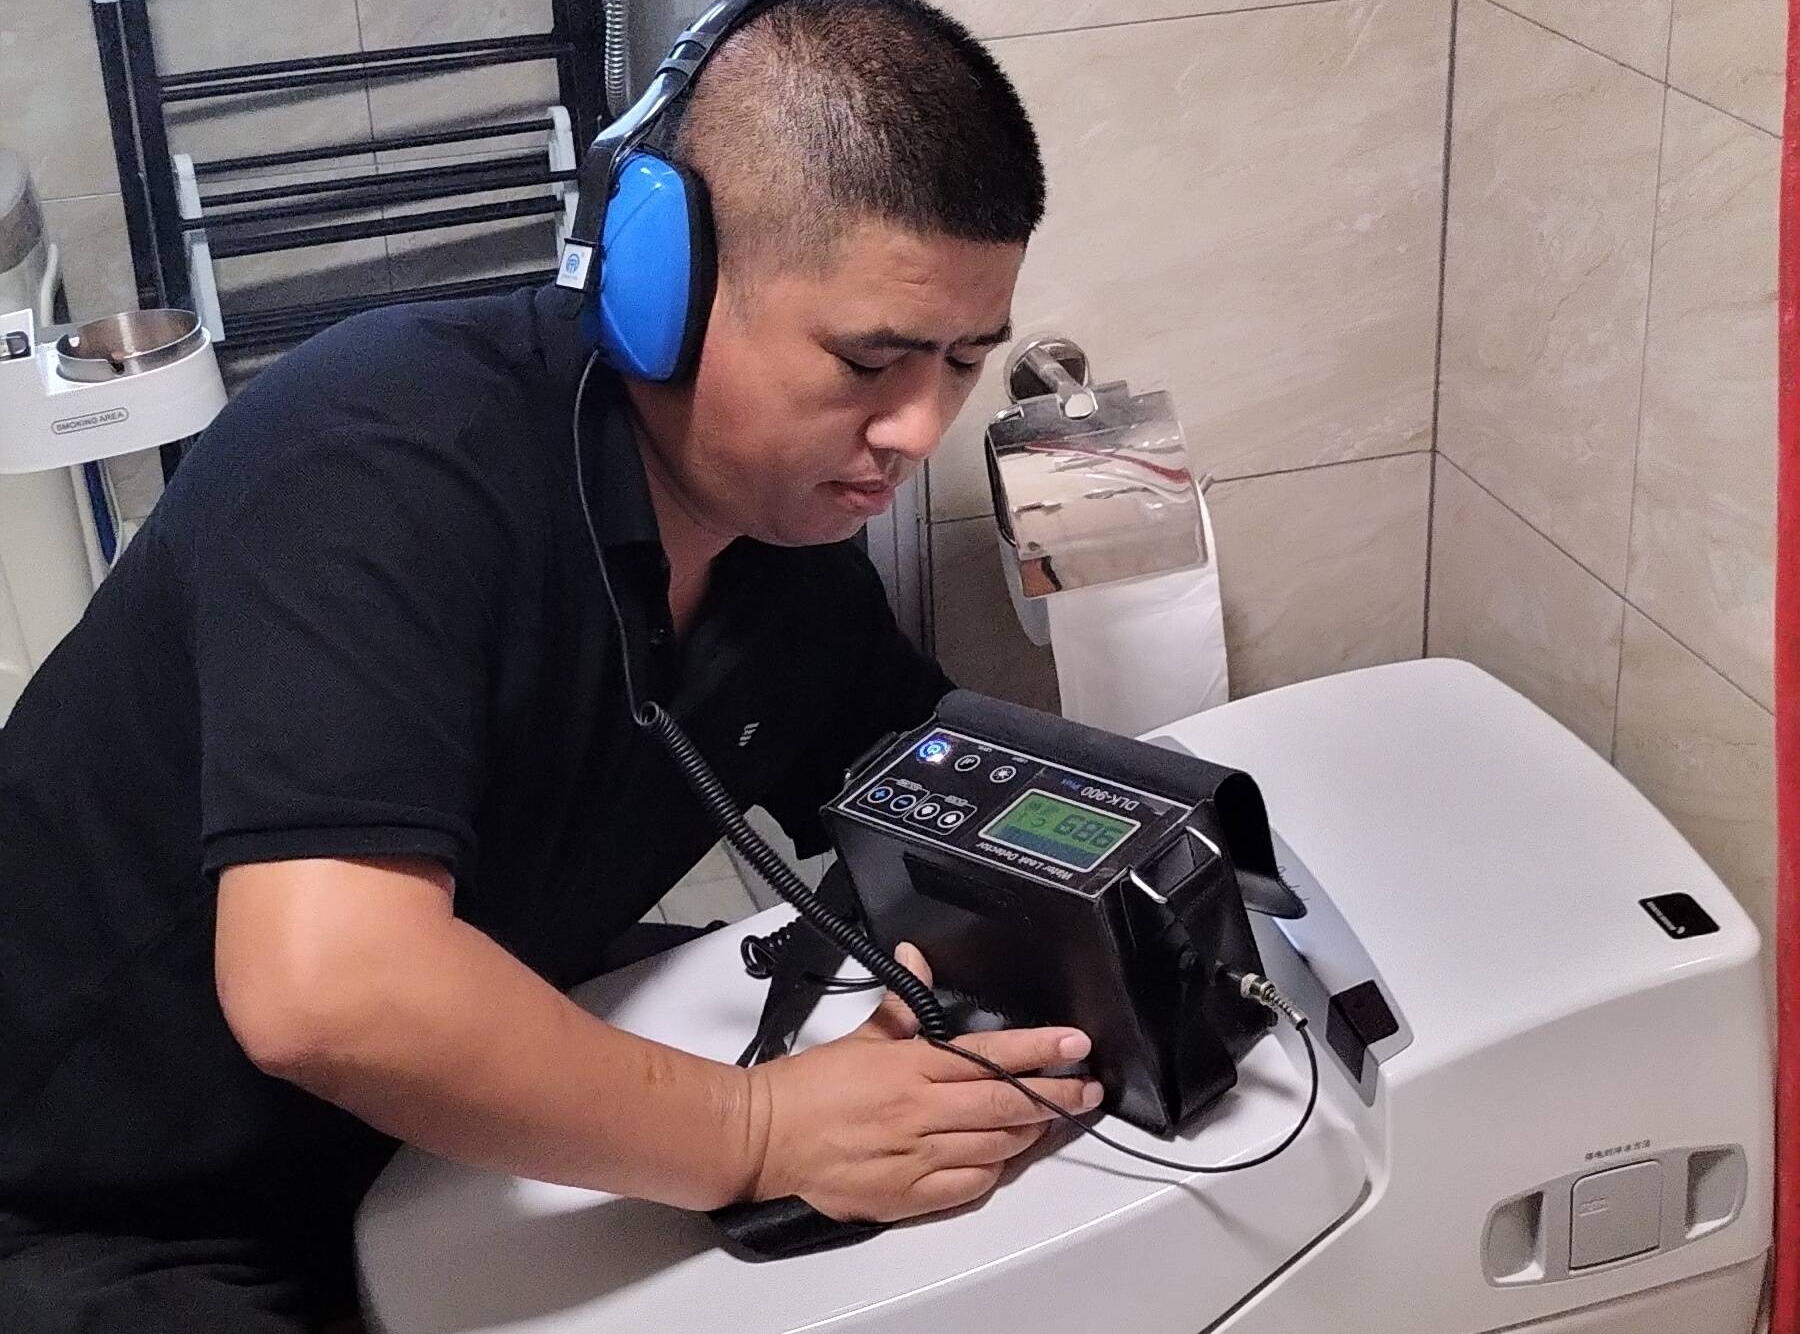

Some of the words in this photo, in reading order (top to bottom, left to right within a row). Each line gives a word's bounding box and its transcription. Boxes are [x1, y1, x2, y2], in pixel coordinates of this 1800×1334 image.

[56, 417, 98, 431] SMOKING
[100, 411, 125, 422] AREA
[1080, 786, 1140, 811] DLK-900
[976, 841, 1019, 861] Detector
[1018, 855, 1044, 870] Leak
[1042, 865, 1074, 881] Water
